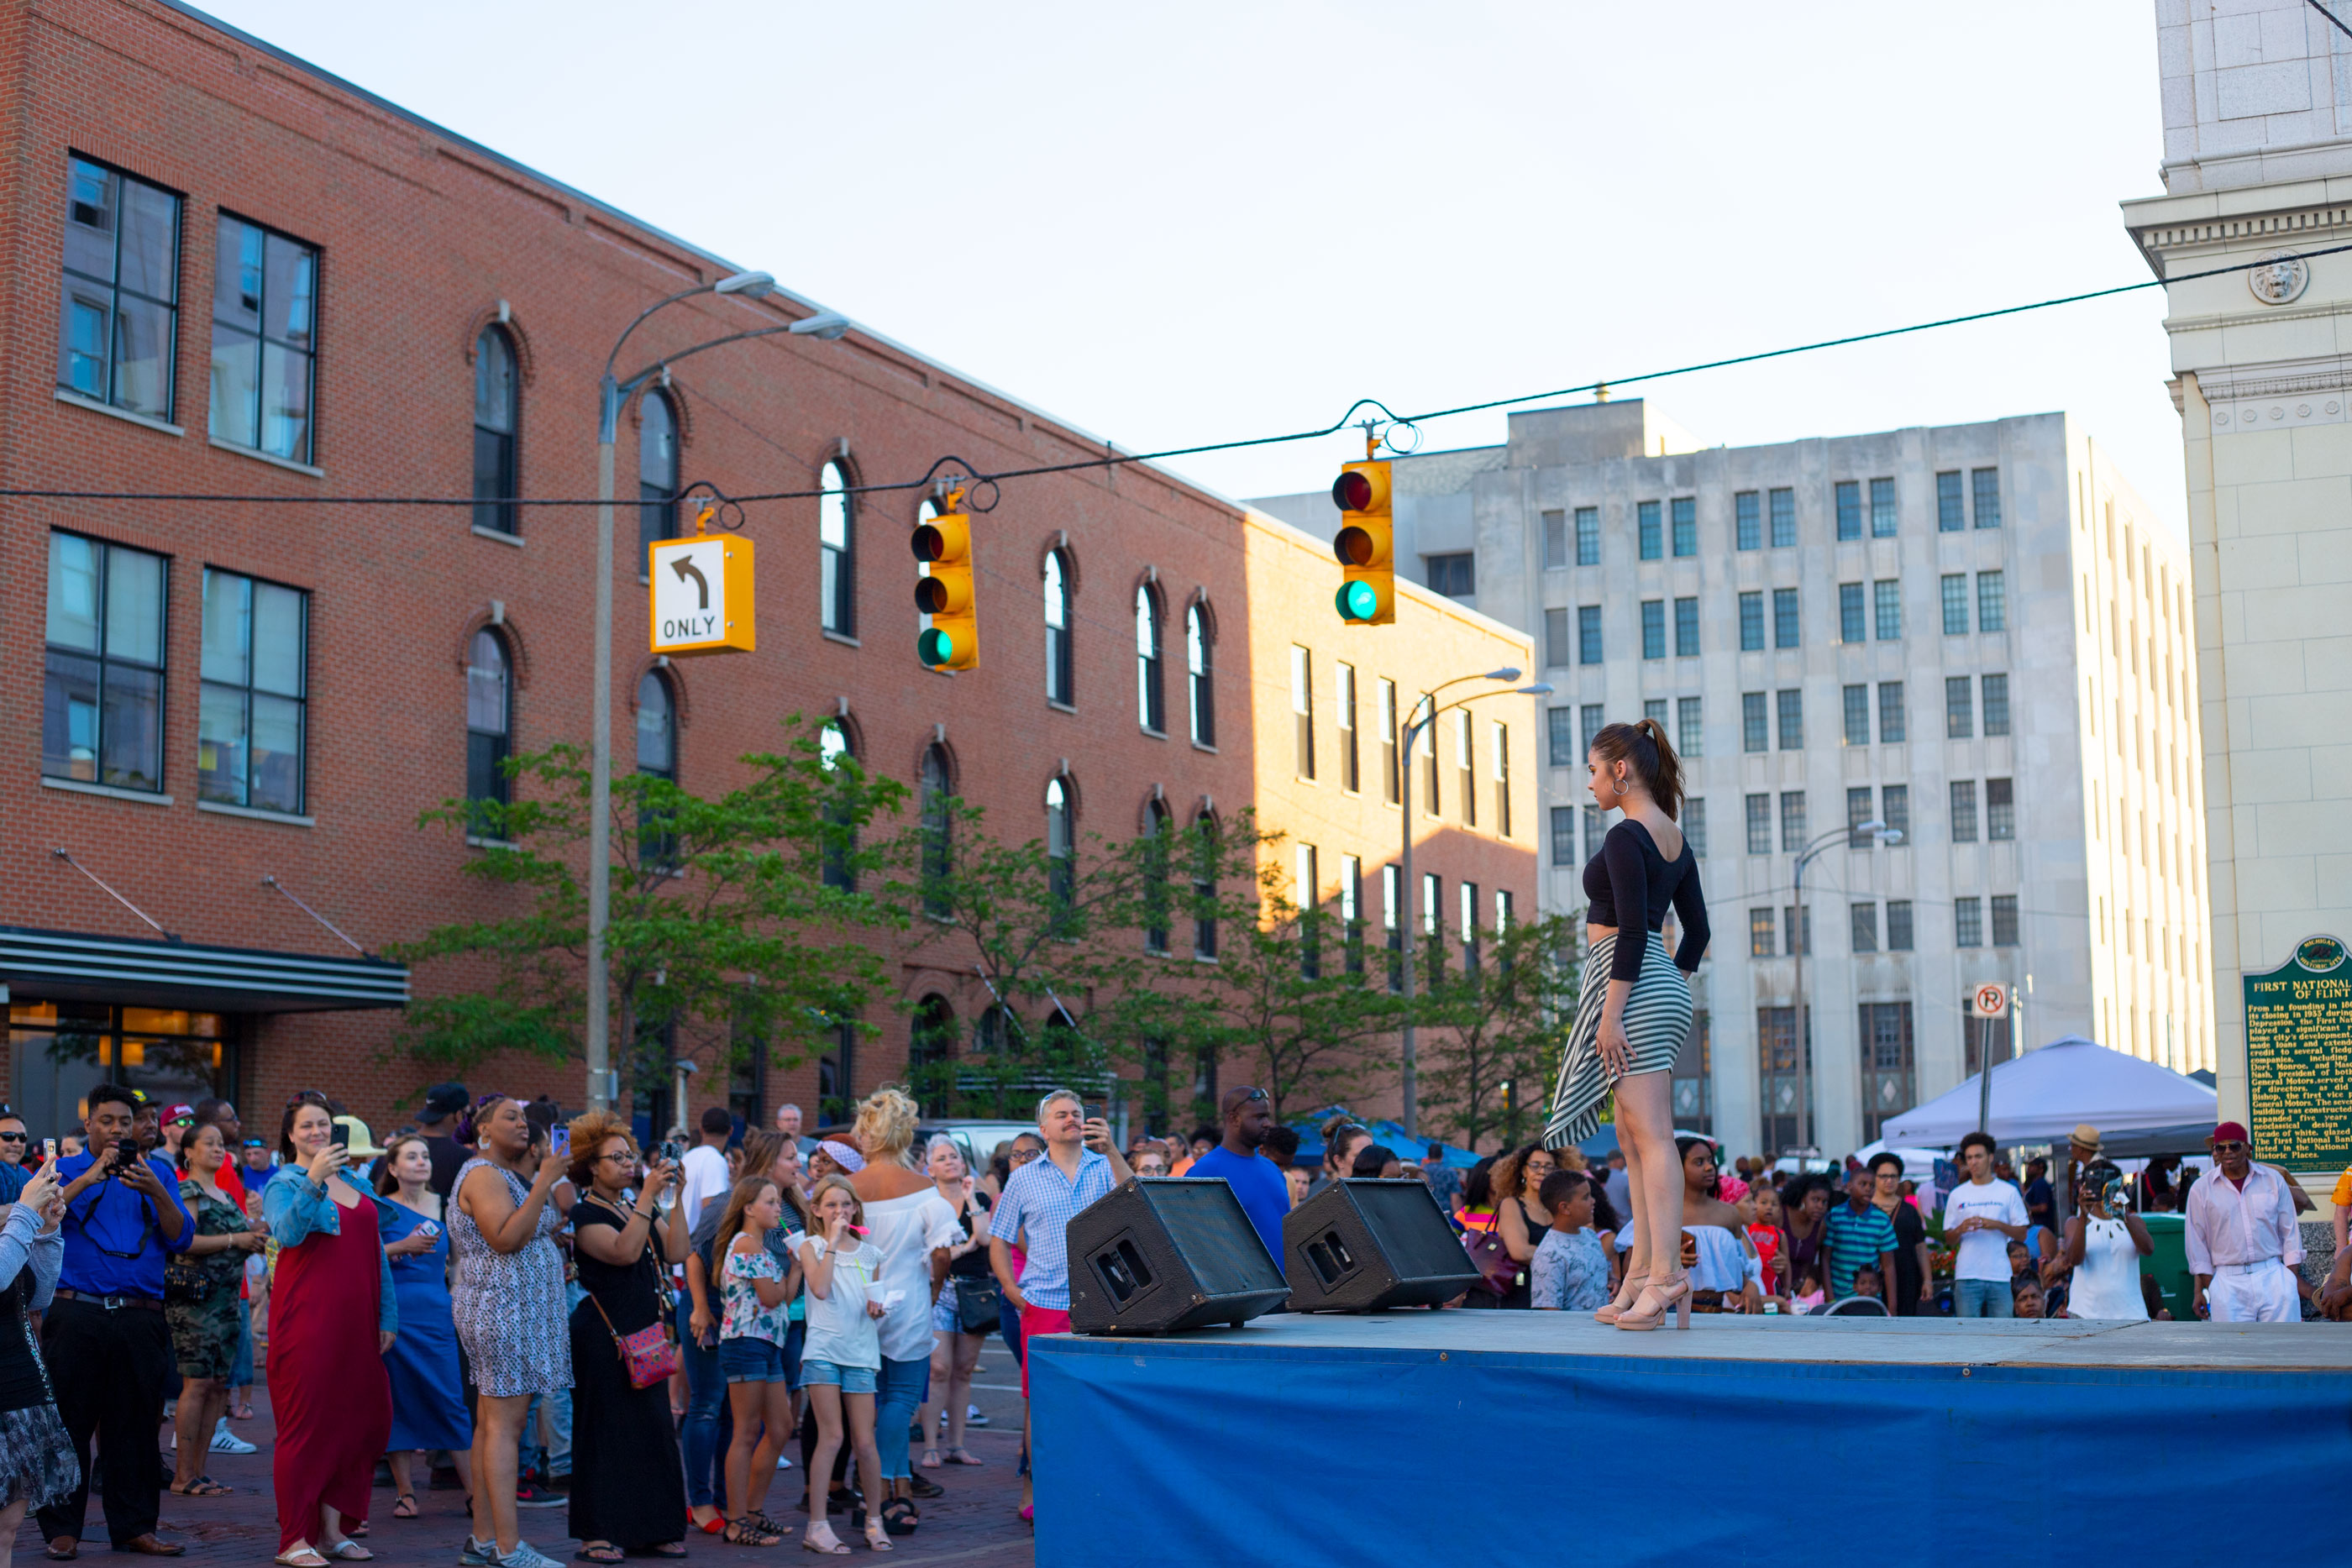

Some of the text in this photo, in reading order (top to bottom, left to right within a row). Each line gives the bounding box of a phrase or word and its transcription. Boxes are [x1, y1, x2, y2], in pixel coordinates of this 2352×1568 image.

[664, 616, 715, 638] ONLY
[2303, 938, 2335, 947] MICHIGAN
[2300, 957, 2328, 969] HISTORIC
[2329, 955, 2342, 967] SITE
[2254, 979, 2351, 992] FIRST NATIONAL
[2296, 989, 2350, 999] OF FLINT
[2250, 1026, 2277, 1035] played
[2297, 1025, 2340, 1033] significant
[2278, 1070, 2316, 1078] president
[2253, 1115, 2292, 1124] expanded
[2254, 1122, 2300, 1130] neoclassical
[2323, 1128, 2350, 1136] glazed
